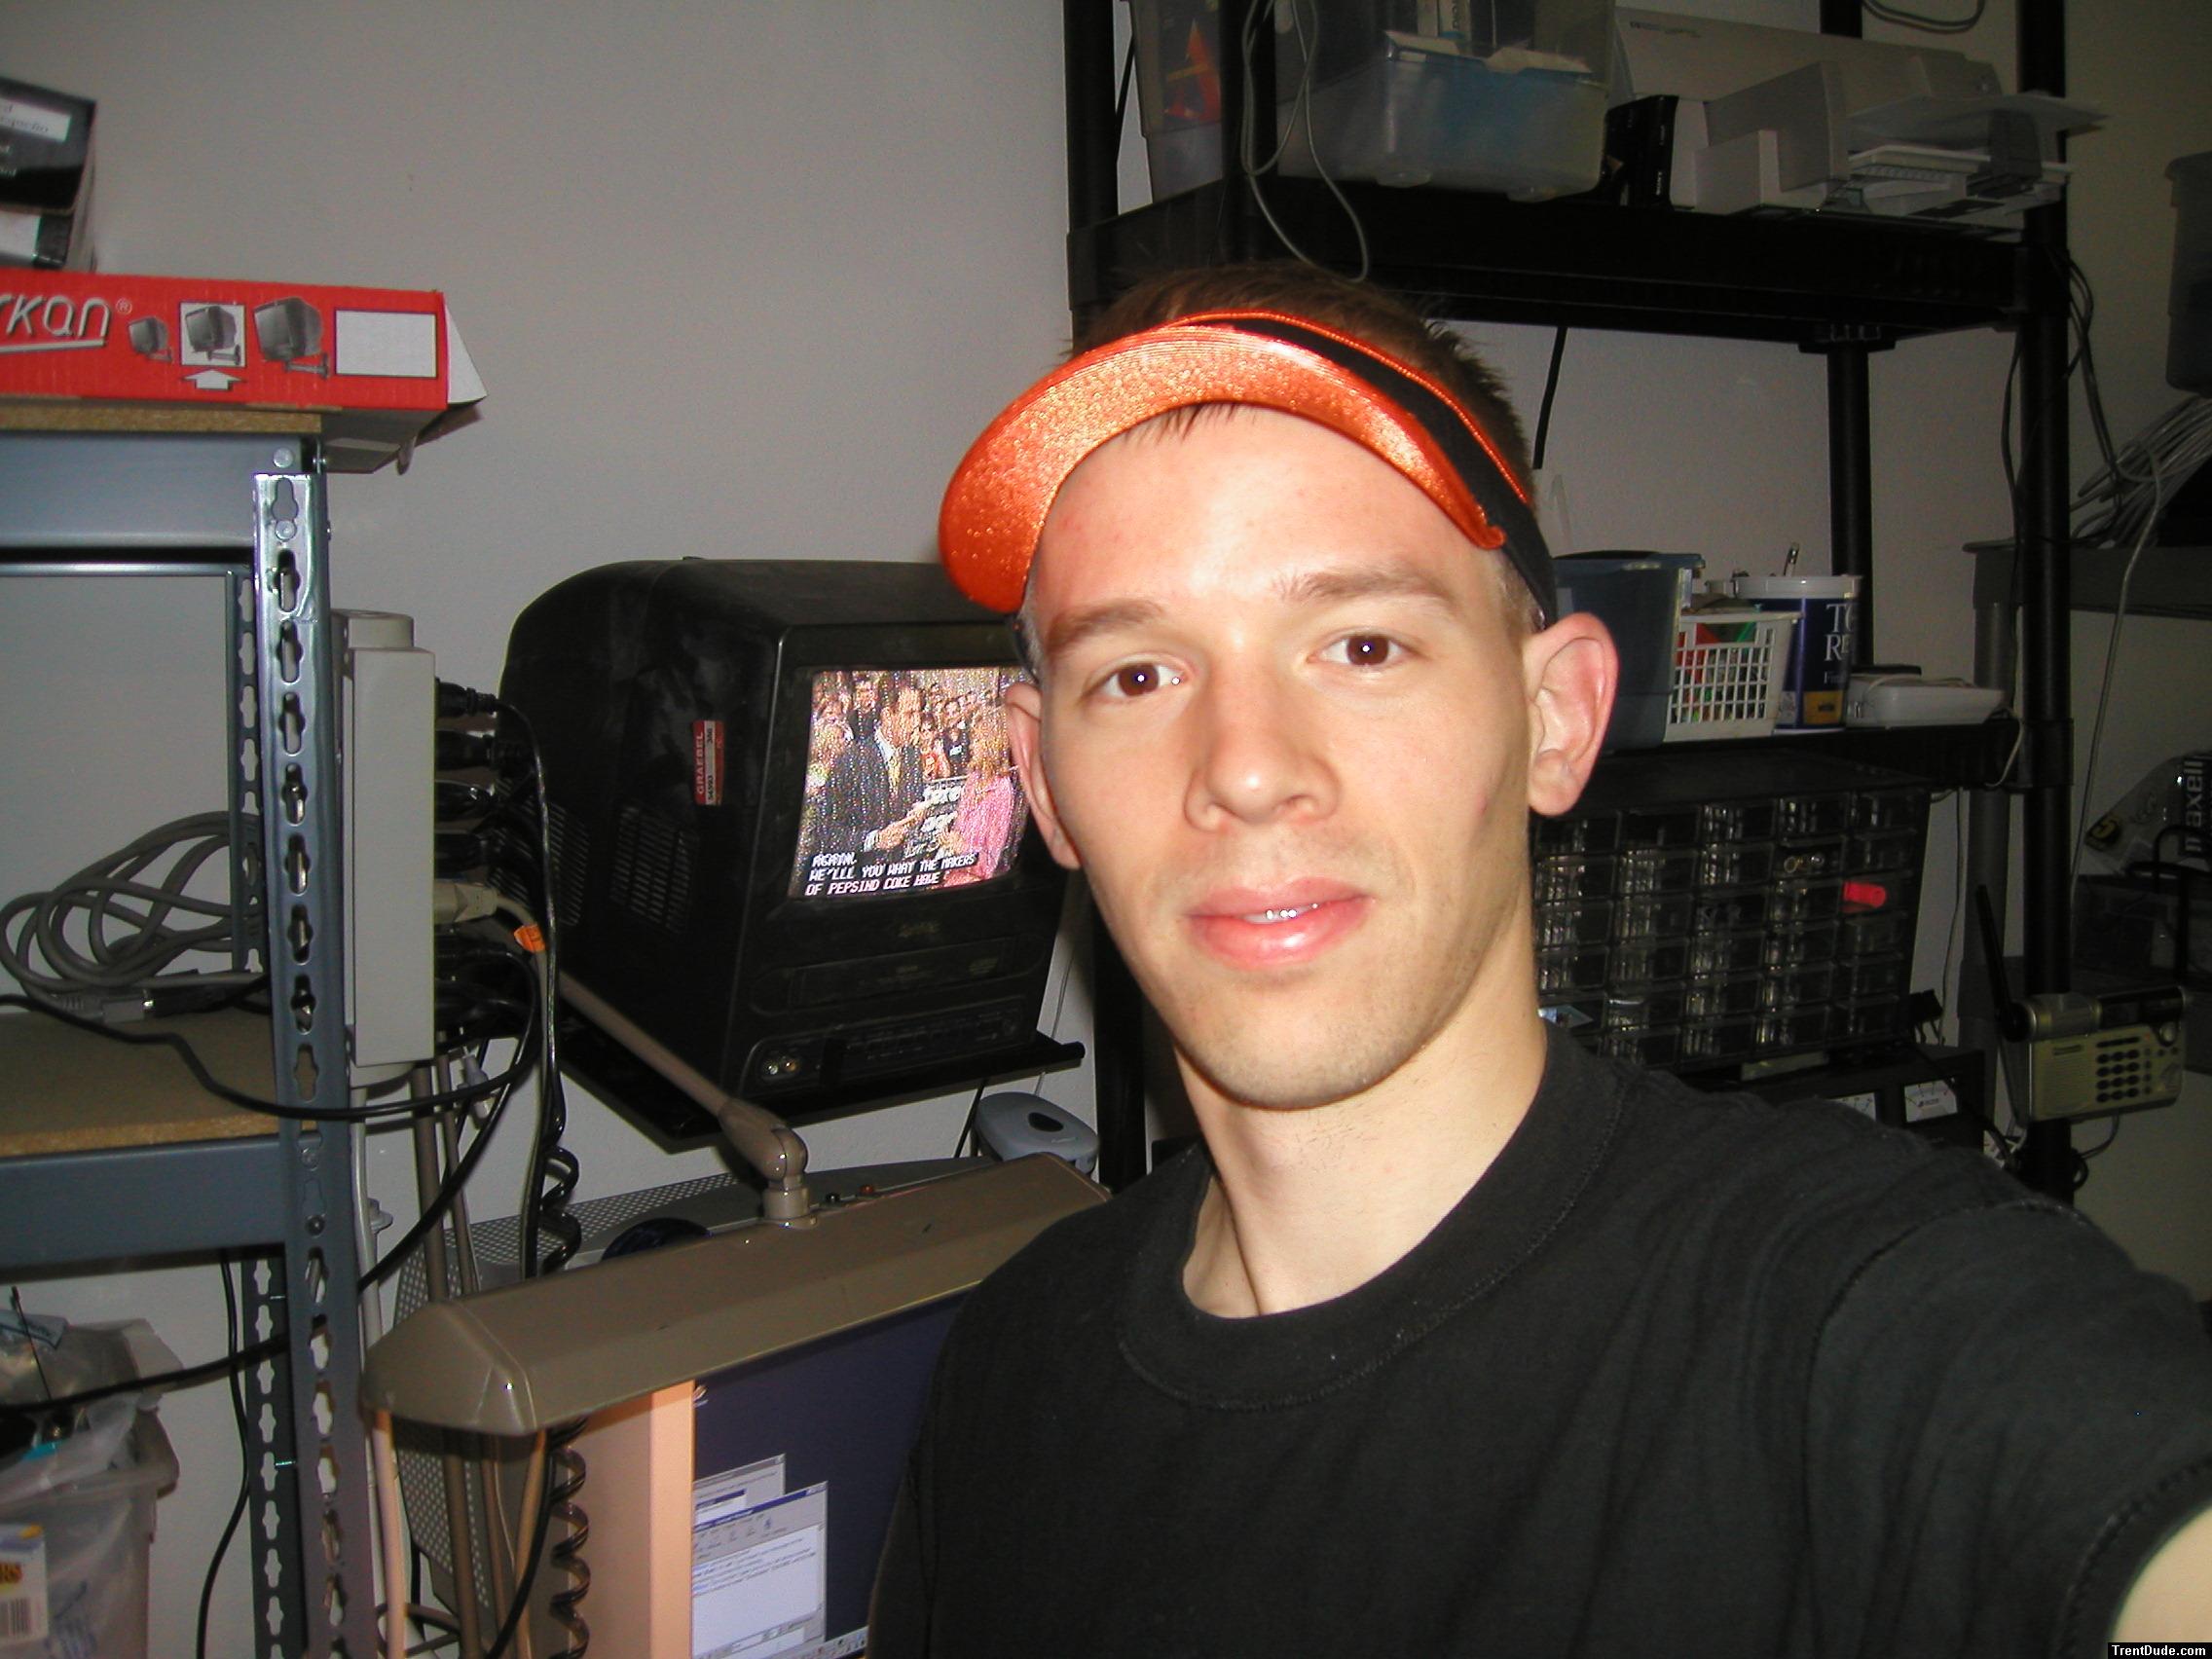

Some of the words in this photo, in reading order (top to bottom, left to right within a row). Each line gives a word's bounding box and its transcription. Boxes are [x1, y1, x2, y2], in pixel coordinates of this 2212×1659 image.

[695, 731, 704, 794] GRAEBEL
[862, 864, 886, 878] YOU
[887, 860, 916, 875] WHAT
[919, 858, 938, 872] THE
[941, 854, 975, 869] MAKERS
[804, 883, 824, 896] OF
[882, 875, 912, 890] COKE
